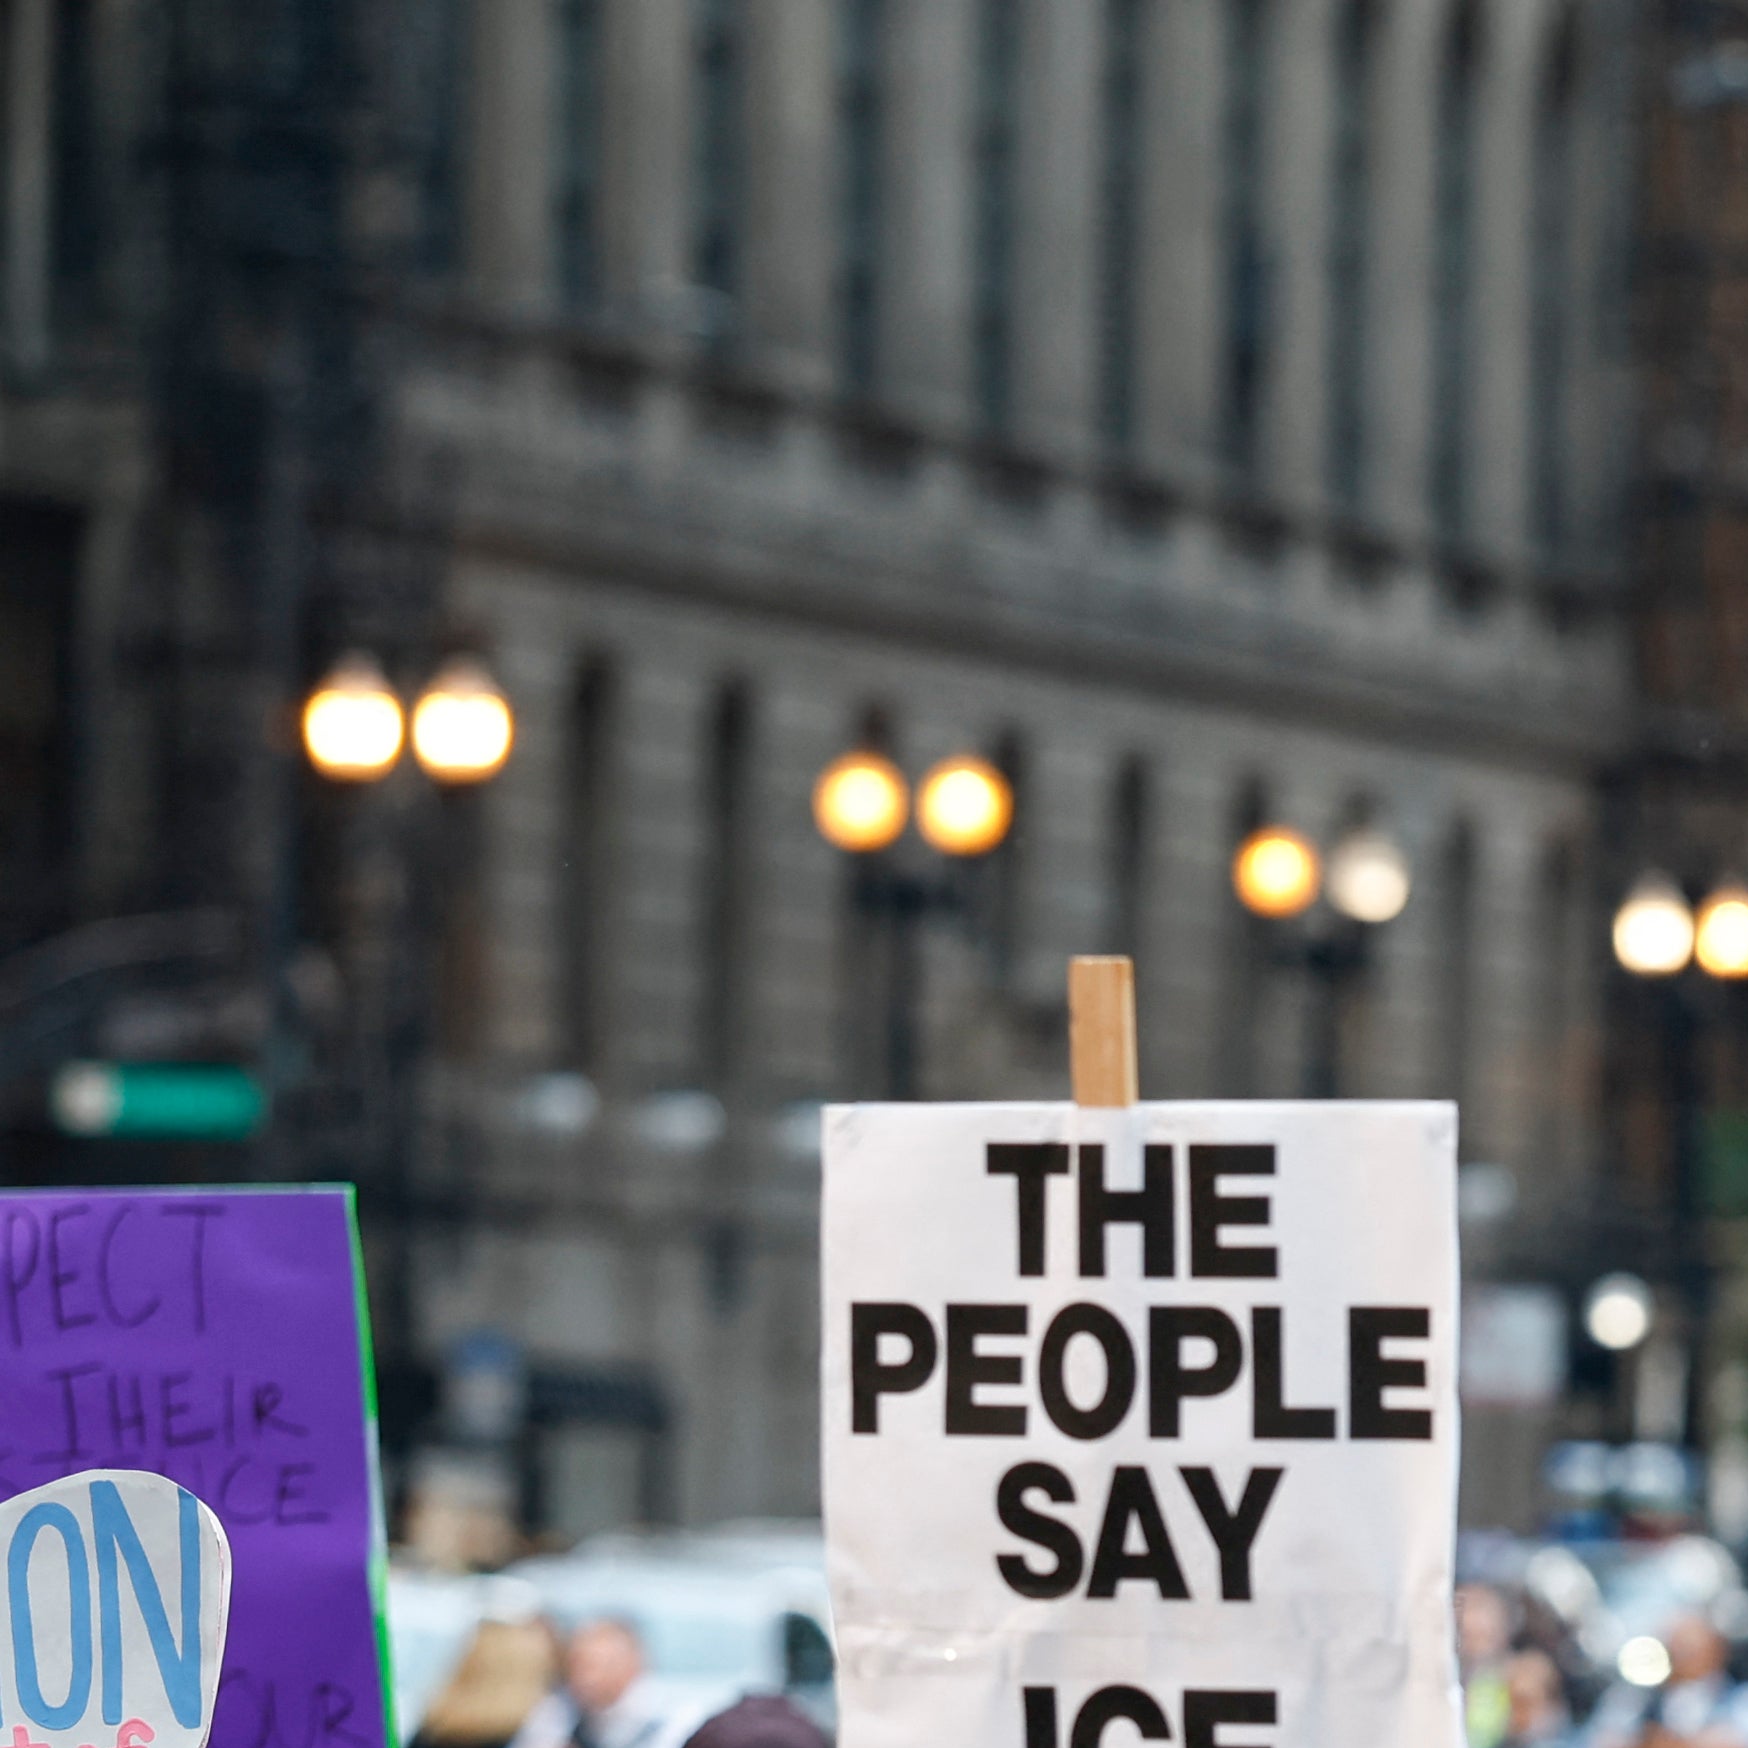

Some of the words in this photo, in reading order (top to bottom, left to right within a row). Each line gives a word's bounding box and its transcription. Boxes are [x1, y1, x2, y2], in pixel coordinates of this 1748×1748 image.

[985, 1142, 1278, 1279] THE
[44, 1362, 312, 1458] THEIR
[850, 1301, 1433, 1441] PEOPLE
[995, 1461, 1284, 1602] SAY
[0, 1479, 202, 1731] ON
